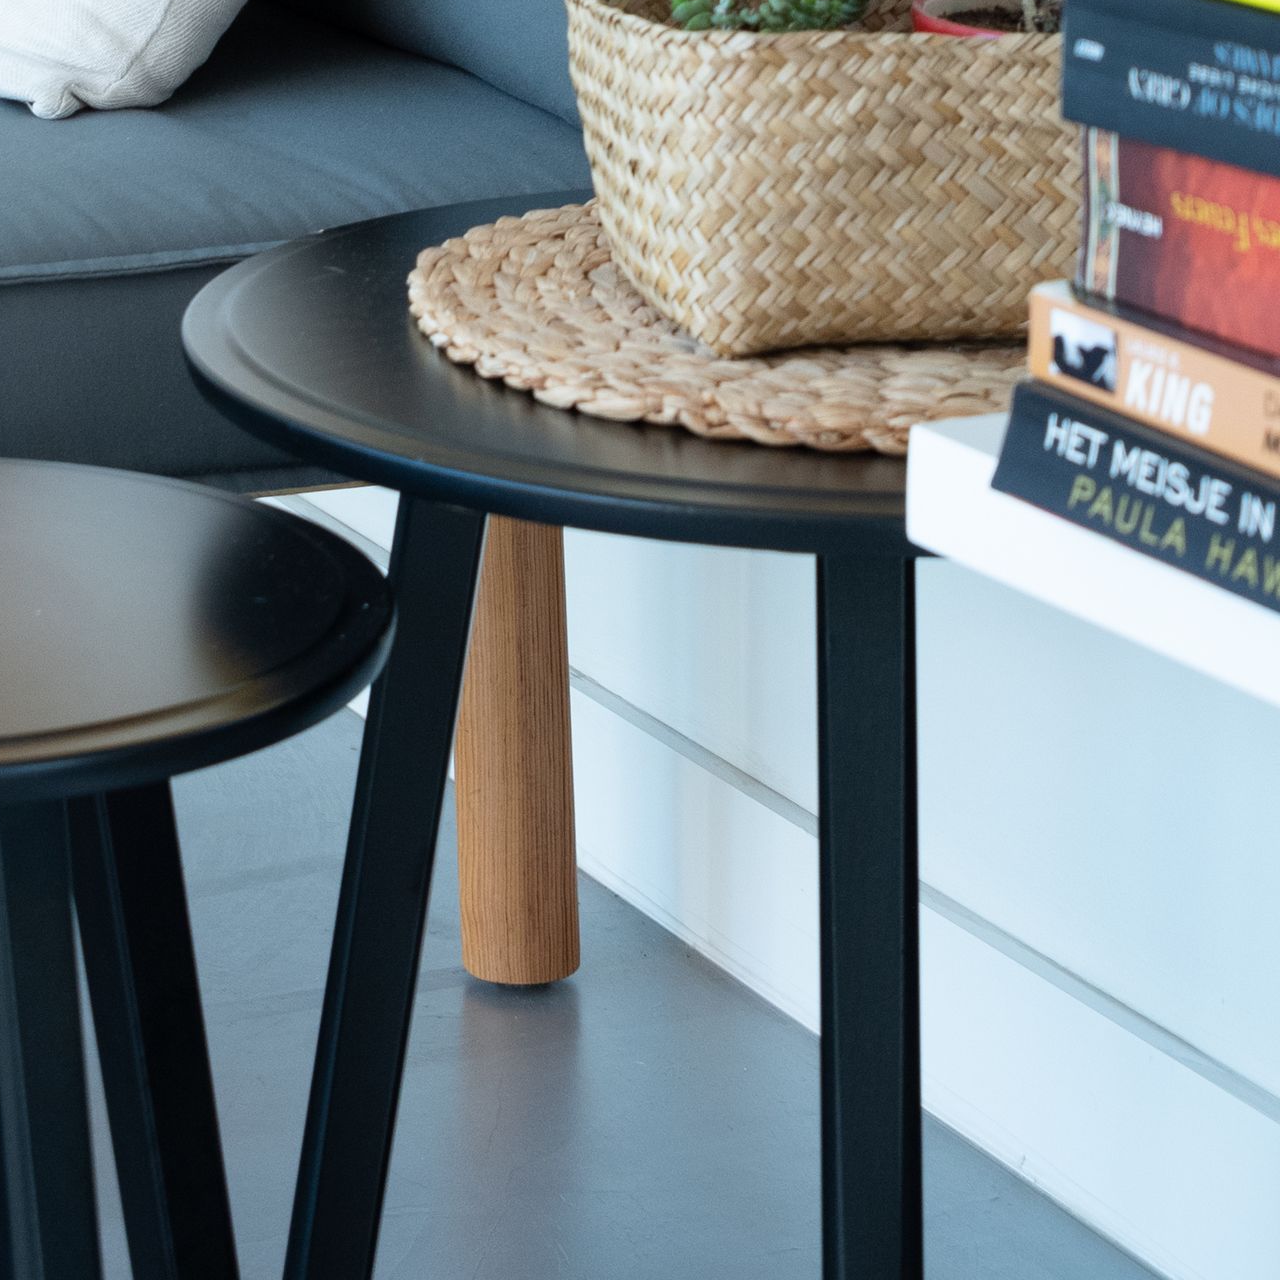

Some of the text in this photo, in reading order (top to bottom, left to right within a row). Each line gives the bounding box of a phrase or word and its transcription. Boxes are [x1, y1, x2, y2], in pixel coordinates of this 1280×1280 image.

[1124, 356, 1215, 437] KING
[1043, 411, 1277, 542] HET MEISJE IN
[1065, 473, 1189, 558] PAULA
